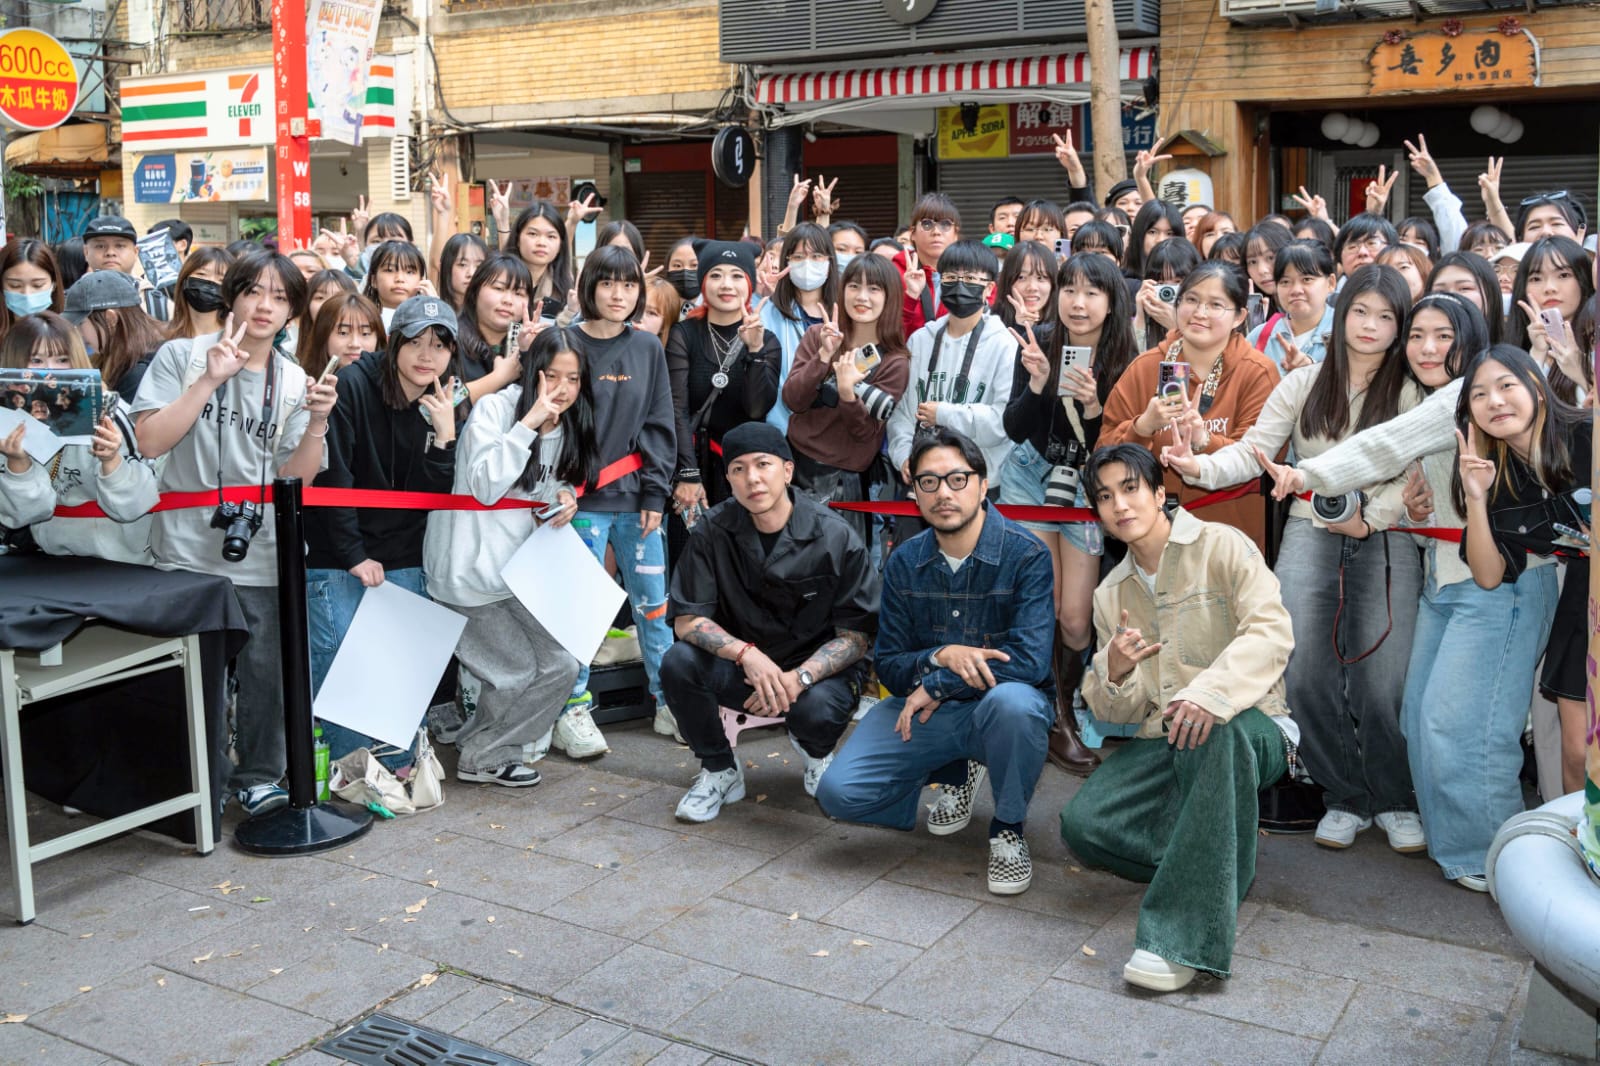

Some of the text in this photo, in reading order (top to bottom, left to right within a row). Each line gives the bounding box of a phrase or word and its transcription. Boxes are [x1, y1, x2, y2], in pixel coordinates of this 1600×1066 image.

[0, 44, 69, 77] 600cc
[0, 84, 68, 111] 木瓜牛奶
[293, 161, 308, 177] W
[294, 192, 310, 207] 58
[201, 402, 277, 439] REFINED
